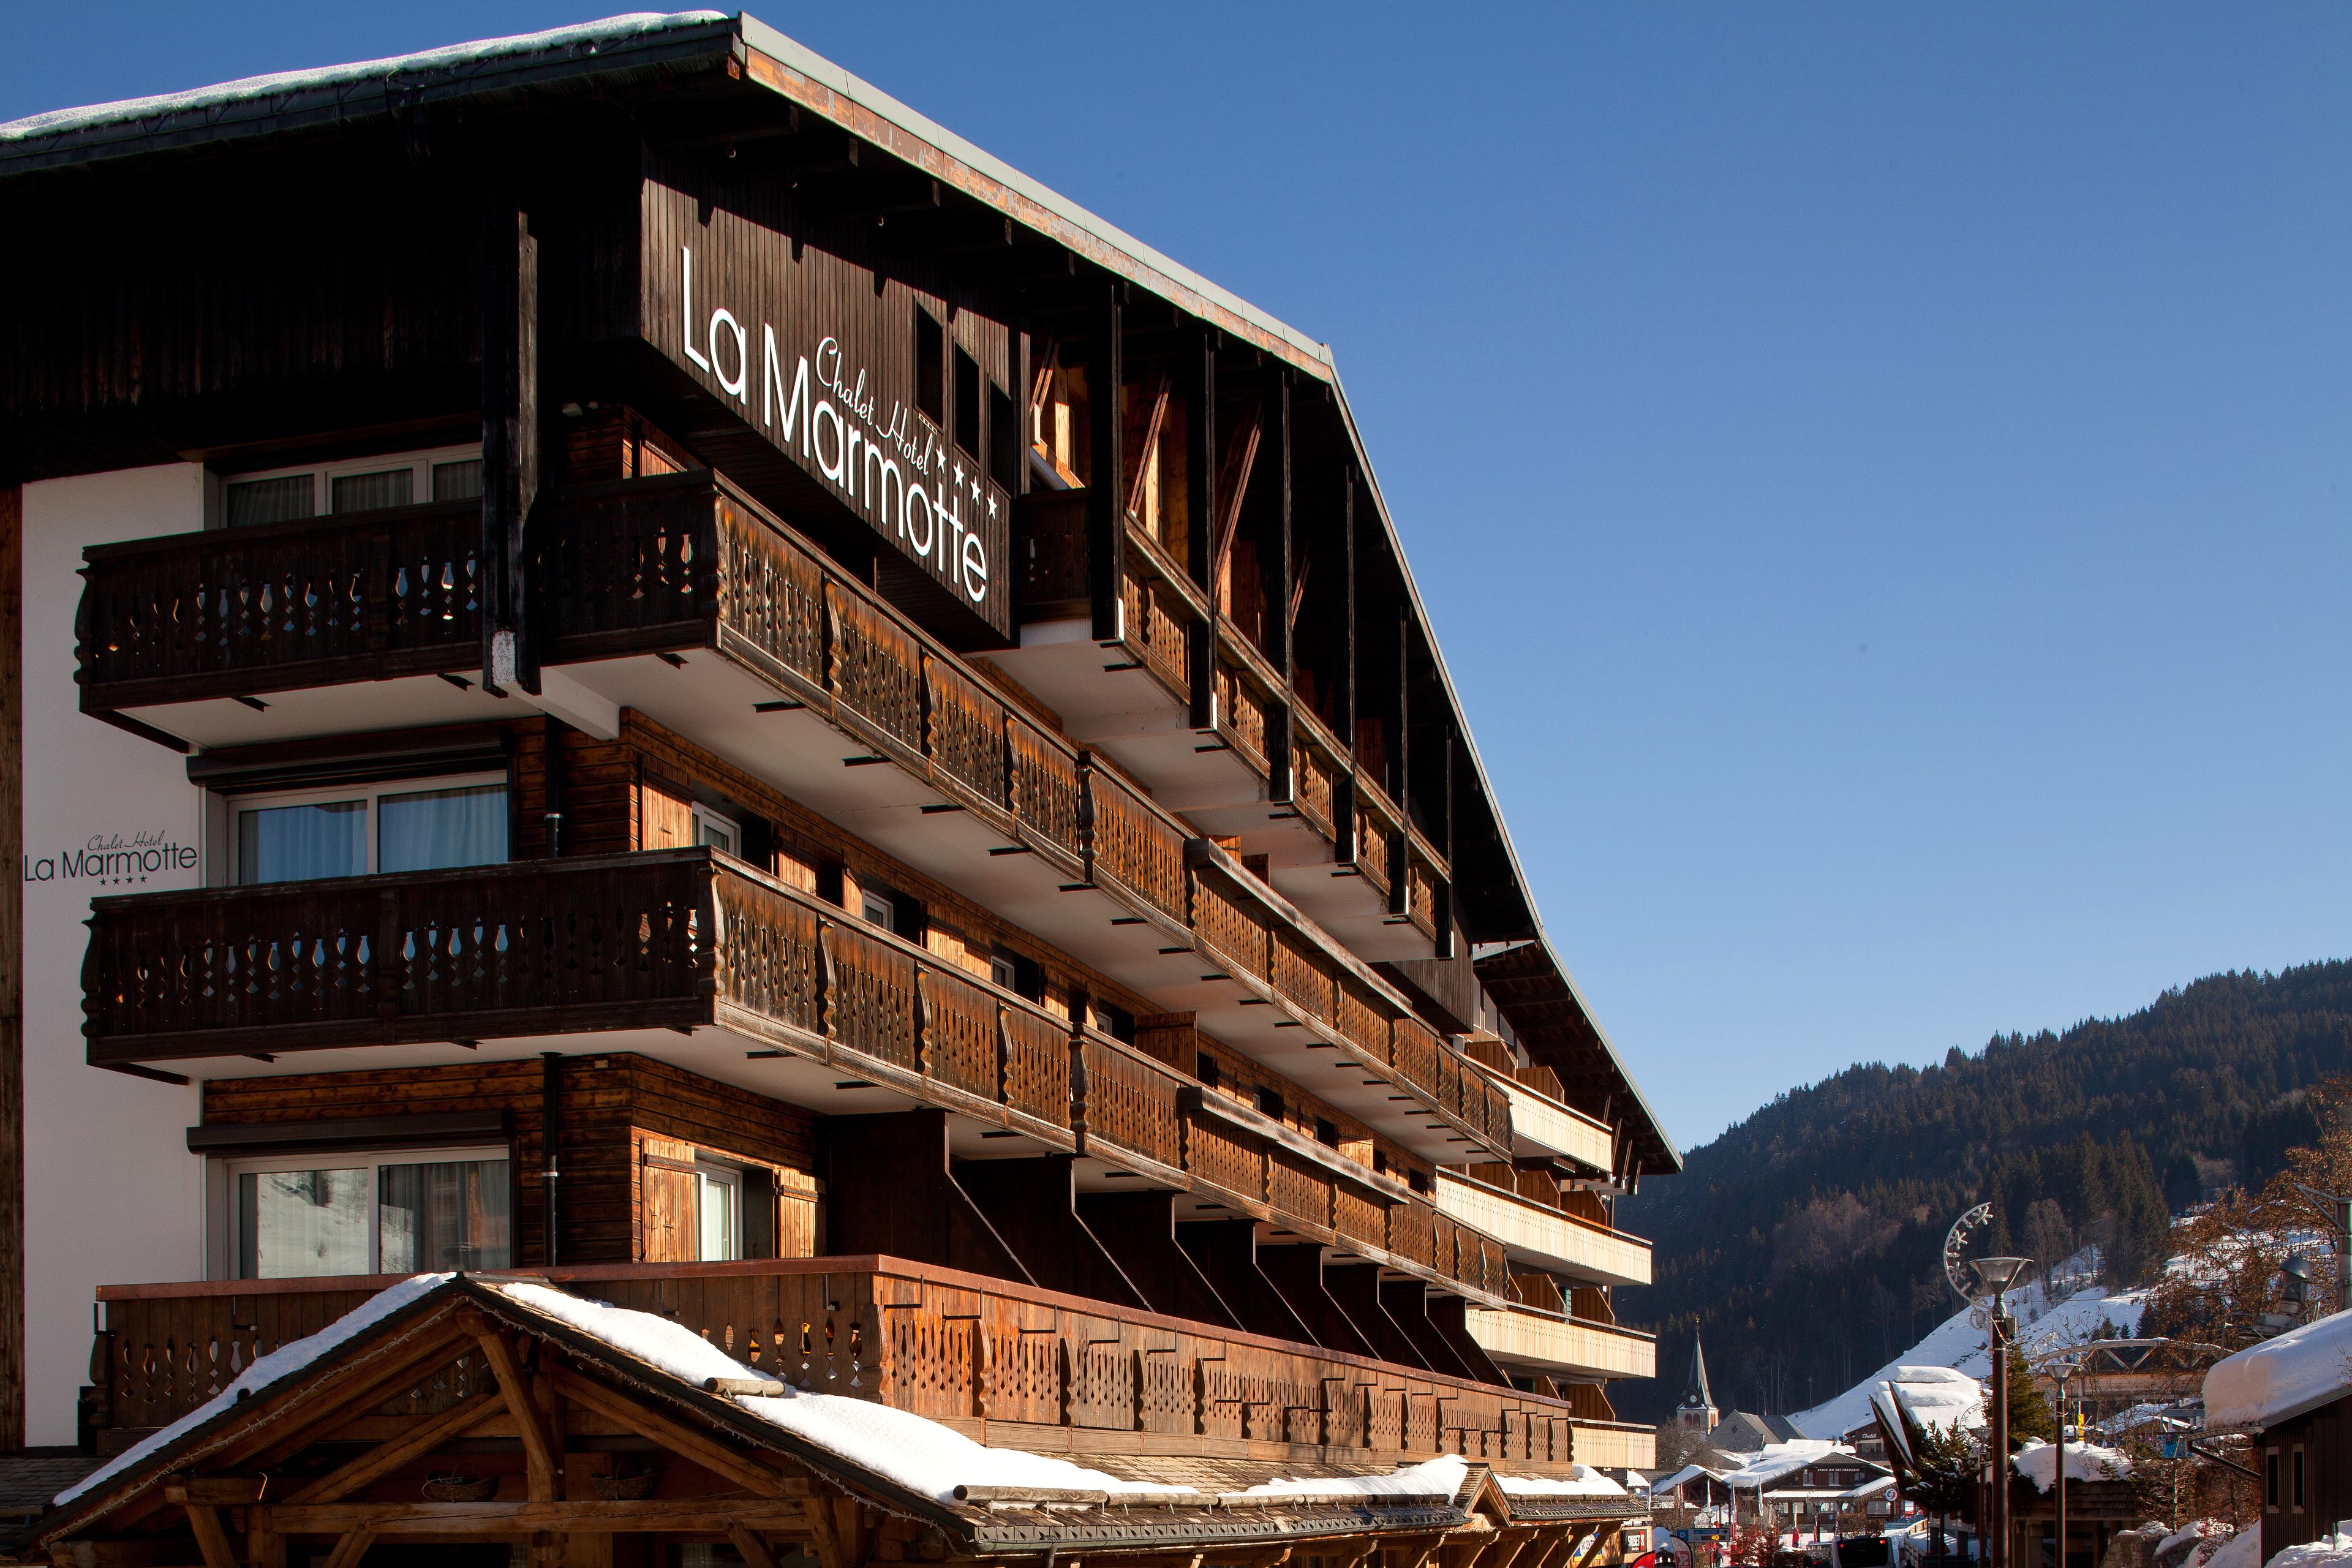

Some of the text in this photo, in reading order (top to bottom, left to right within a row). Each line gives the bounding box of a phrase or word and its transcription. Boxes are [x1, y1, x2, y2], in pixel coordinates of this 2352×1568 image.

[683, 245, 987, 602] La Marmotte
[816, 336, 933, 475] Chalet Hotel
[24, 842, 198, 882] La Marmotte
[87, 829, 165, 851] Chalet Hotel
